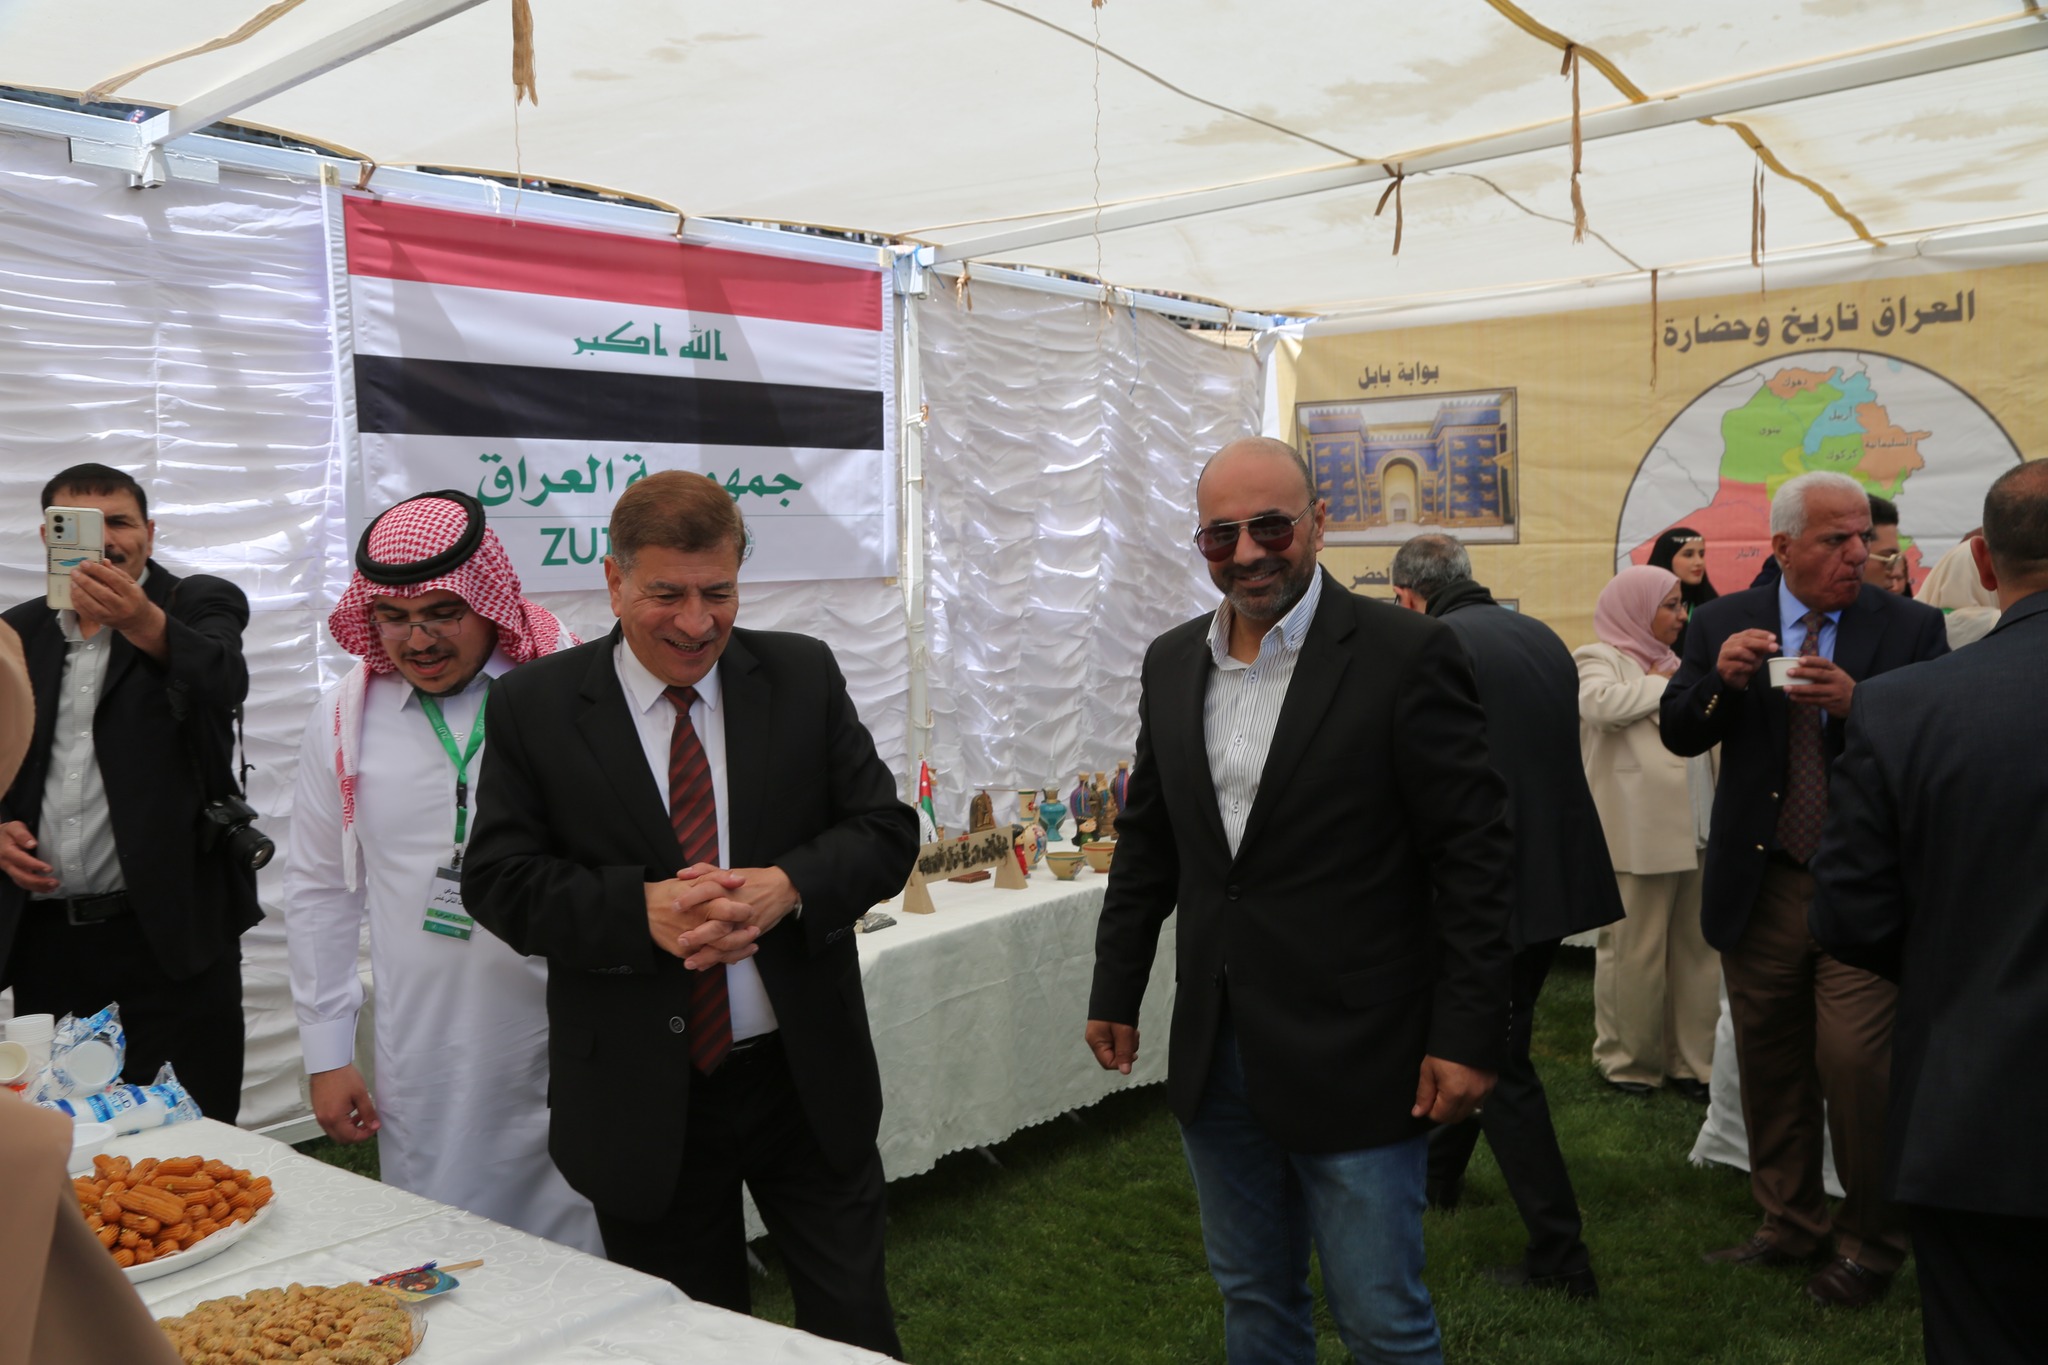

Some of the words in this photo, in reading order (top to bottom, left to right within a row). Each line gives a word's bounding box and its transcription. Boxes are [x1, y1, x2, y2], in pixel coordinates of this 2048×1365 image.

[1781, 302, 1859, 344] تاريخ
[1872, 288, 1975, 337] العراق
[1663, 314, 1770, 352] وحضارة
[1358, 364, 1391, 390] بابل
[1397, 361, 1440, 386] بوابة
[477, 453, 614, 508] العراق
[1349, 566, 1390, 590] لحضر
